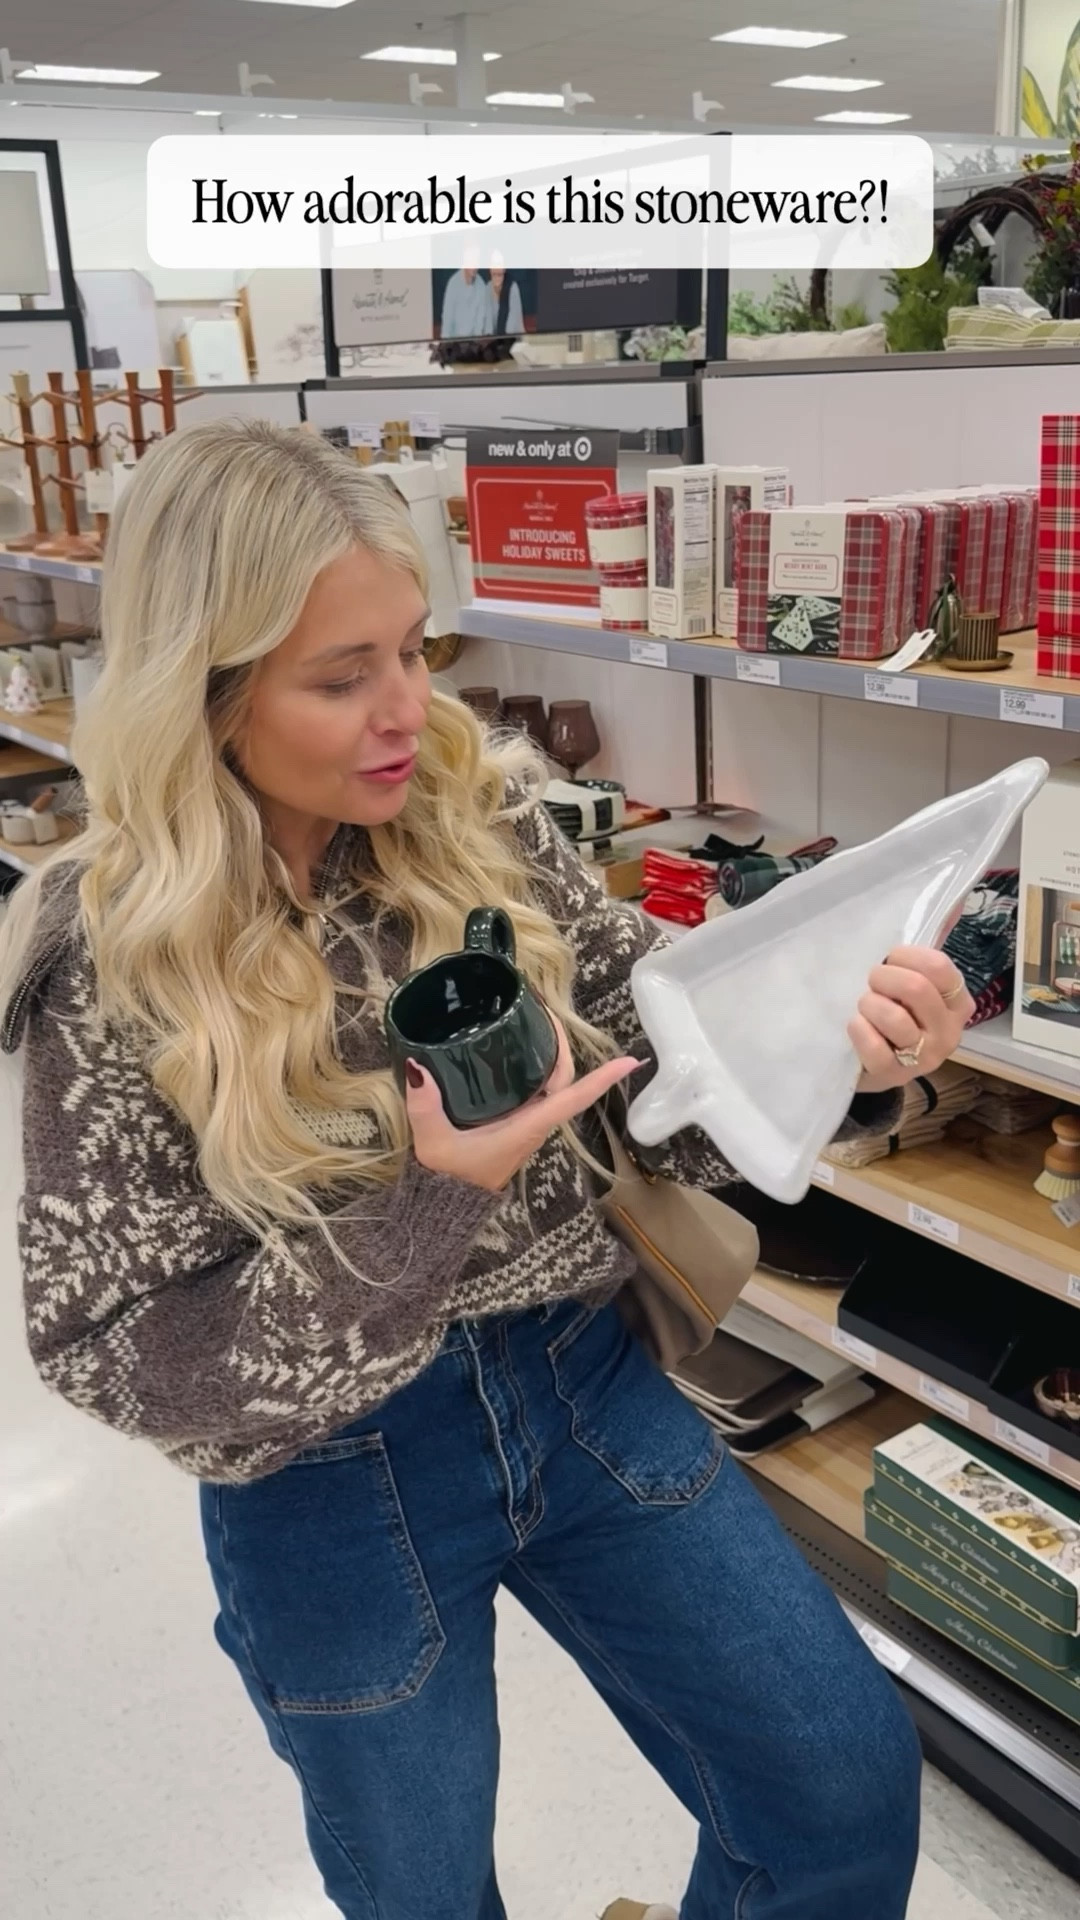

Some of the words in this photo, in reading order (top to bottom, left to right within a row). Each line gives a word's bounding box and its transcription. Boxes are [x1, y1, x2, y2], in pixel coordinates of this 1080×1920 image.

[617, 274, 628, 284] for
[488, 443, 515, 457] new
[516, 440, 527, 457] &
[528, 440, 555, 461] only
[557, 441, 571, 457] at
[509, 528, 576, 545] INTRODUCING
[502, 545, 543, 561] HOLIDAY
[544, 547, 586, 563] SWEETS
[1004, 698, 1026, 710] 12.99
